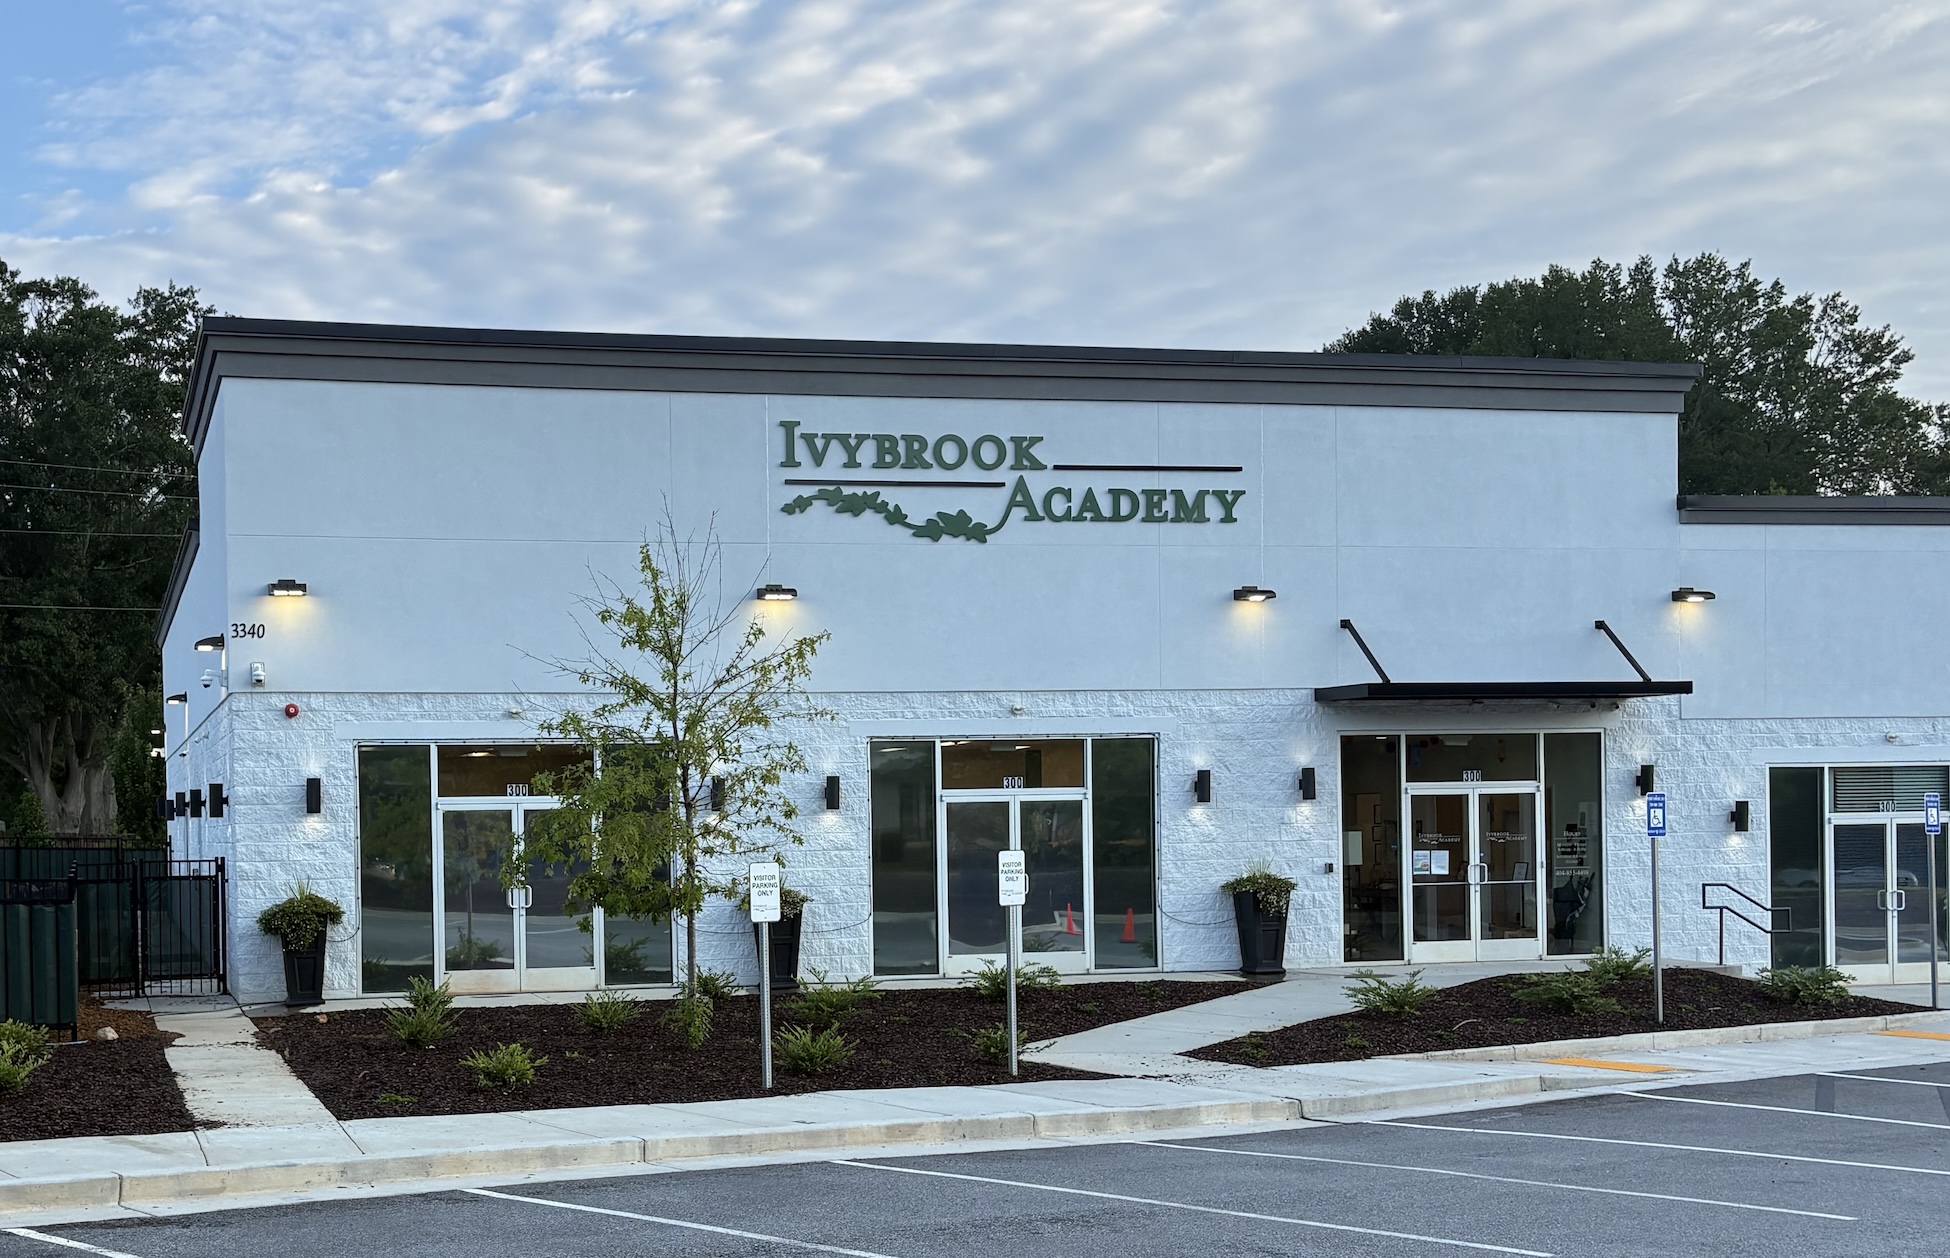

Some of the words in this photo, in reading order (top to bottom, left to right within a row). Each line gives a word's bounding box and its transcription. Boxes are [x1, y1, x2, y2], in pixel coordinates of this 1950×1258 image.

[780, 420, 1047, 471] IVYBROOK
[1005, 474, 1246, 523] ACADEMY
[231, 623, 266, 639] 3340
[1464, 771, 1481, 782] 300
[1004, 777, 1023, 788] 300
[508, 784, 527, 796] 300
[753, 874, 776, 882] VISITOR
[751, 881, 778, 889] PARKING
[757, 889, 774, 897] ONLY
